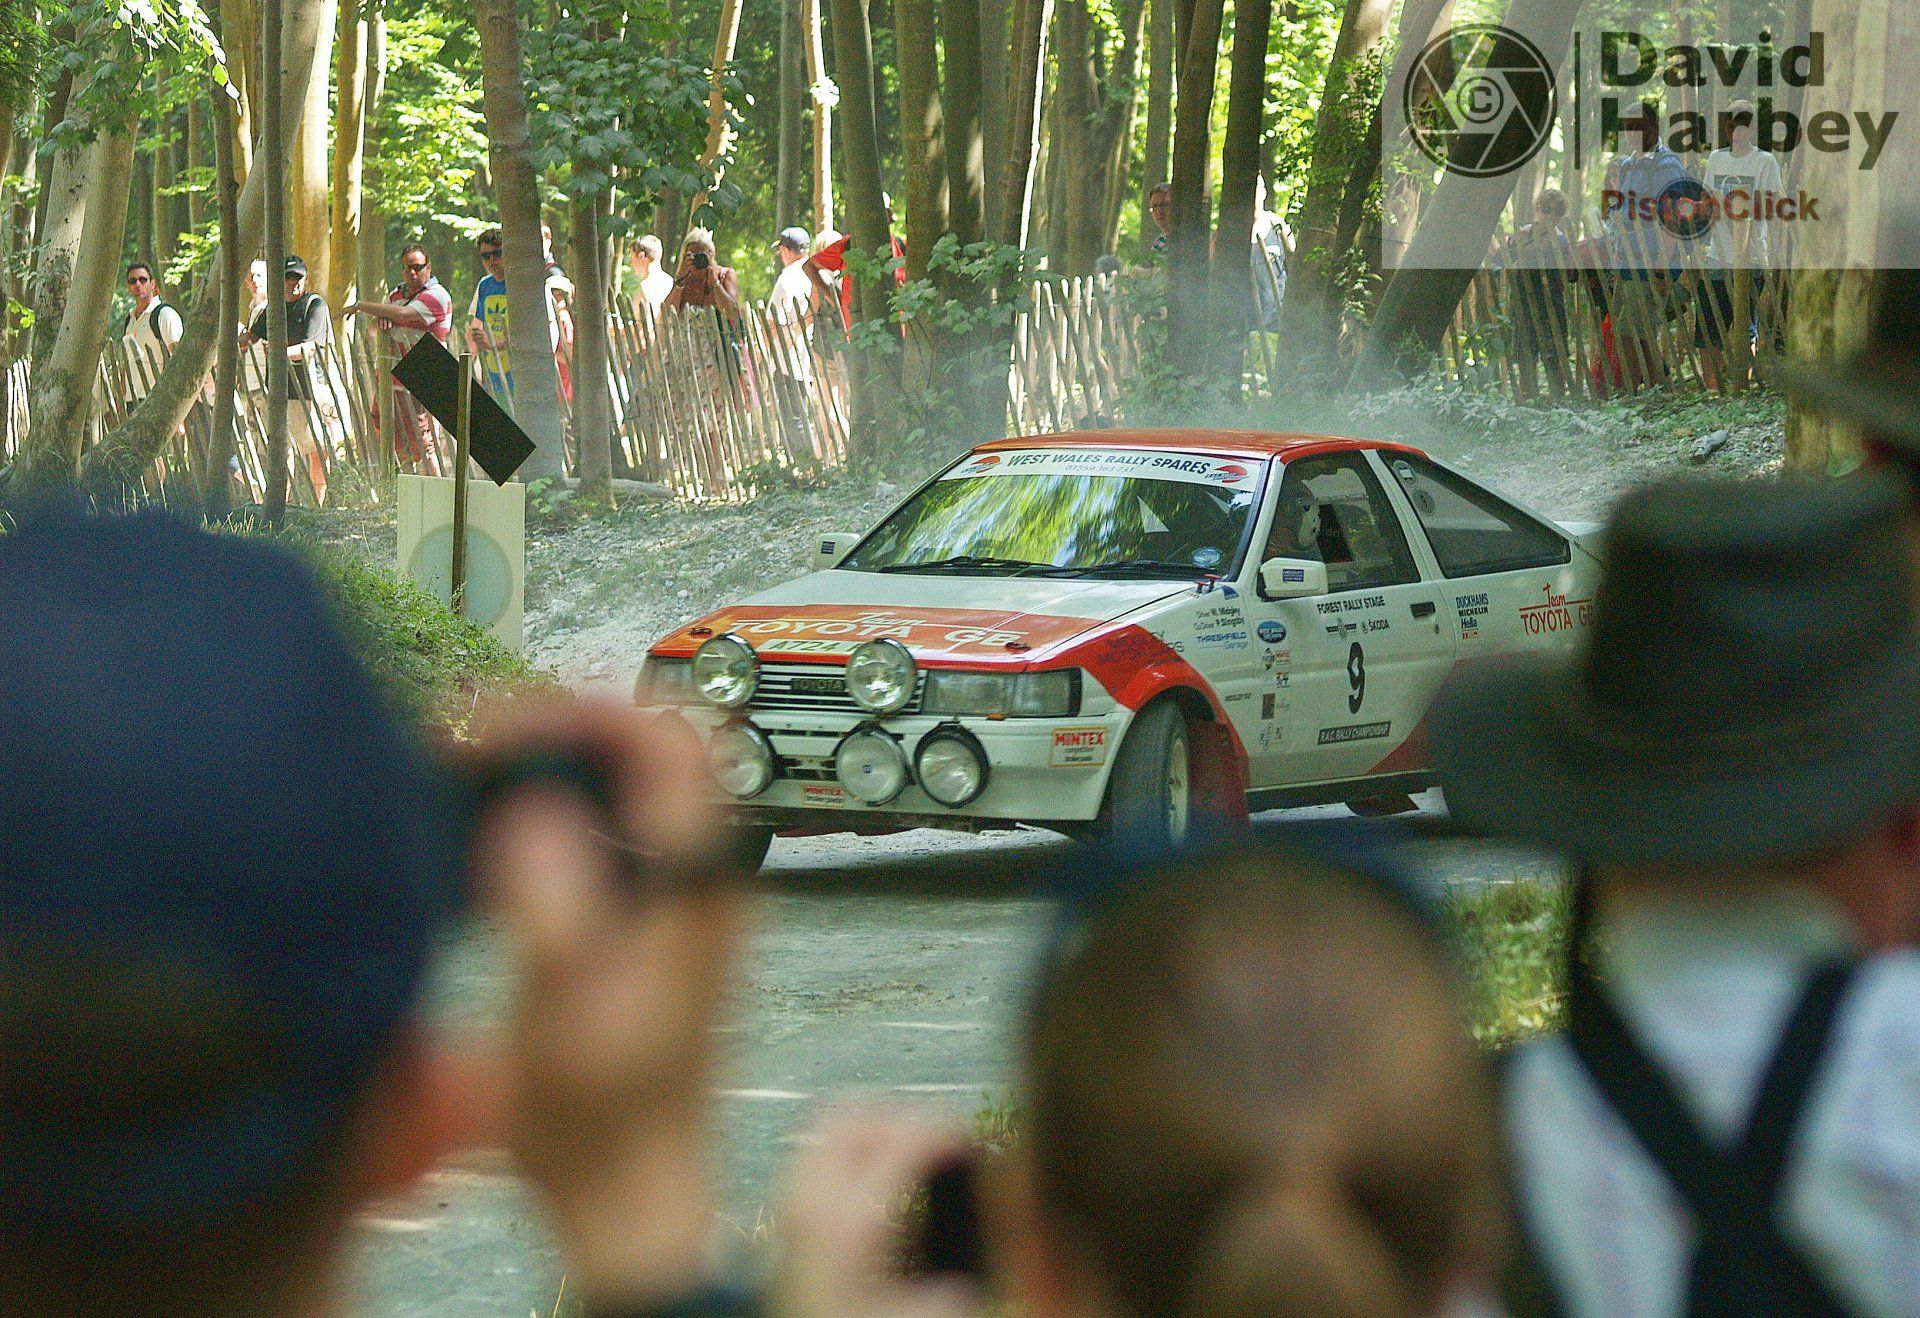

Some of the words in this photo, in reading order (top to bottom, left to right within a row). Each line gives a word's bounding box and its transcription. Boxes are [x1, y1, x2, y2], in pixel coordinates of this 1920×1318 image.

[1007, 454, 1051, 467] WEST
[1051, 454, 1102, 463] WALES
[1104, 455, 1151, 466] RALLY
[1151, 457, 1211, 475] SPARES
[1317, 601, 1342, 614] FOREST
[1343, 598, 1363, 611] RALLY
[1363, 595, 1386, 609] STAGE
[1456, 592, 1489, 609] DUCKHAMS
[1543, 582, 1566, 608] Team
[850, 611, 928, 626] Team
[1458, 606, 1488, 617] MICHELIN
[1461, 617, 1478, 629] Hella
[1520, 608, 1573, 635] TOYOTA
[730, 621, 911, 638] TOYOTA
[943, 628, 1022, 647] GB
[1346, 641, 1366, 715] 9
[1055, 731, 1104, 747] MINTEX
